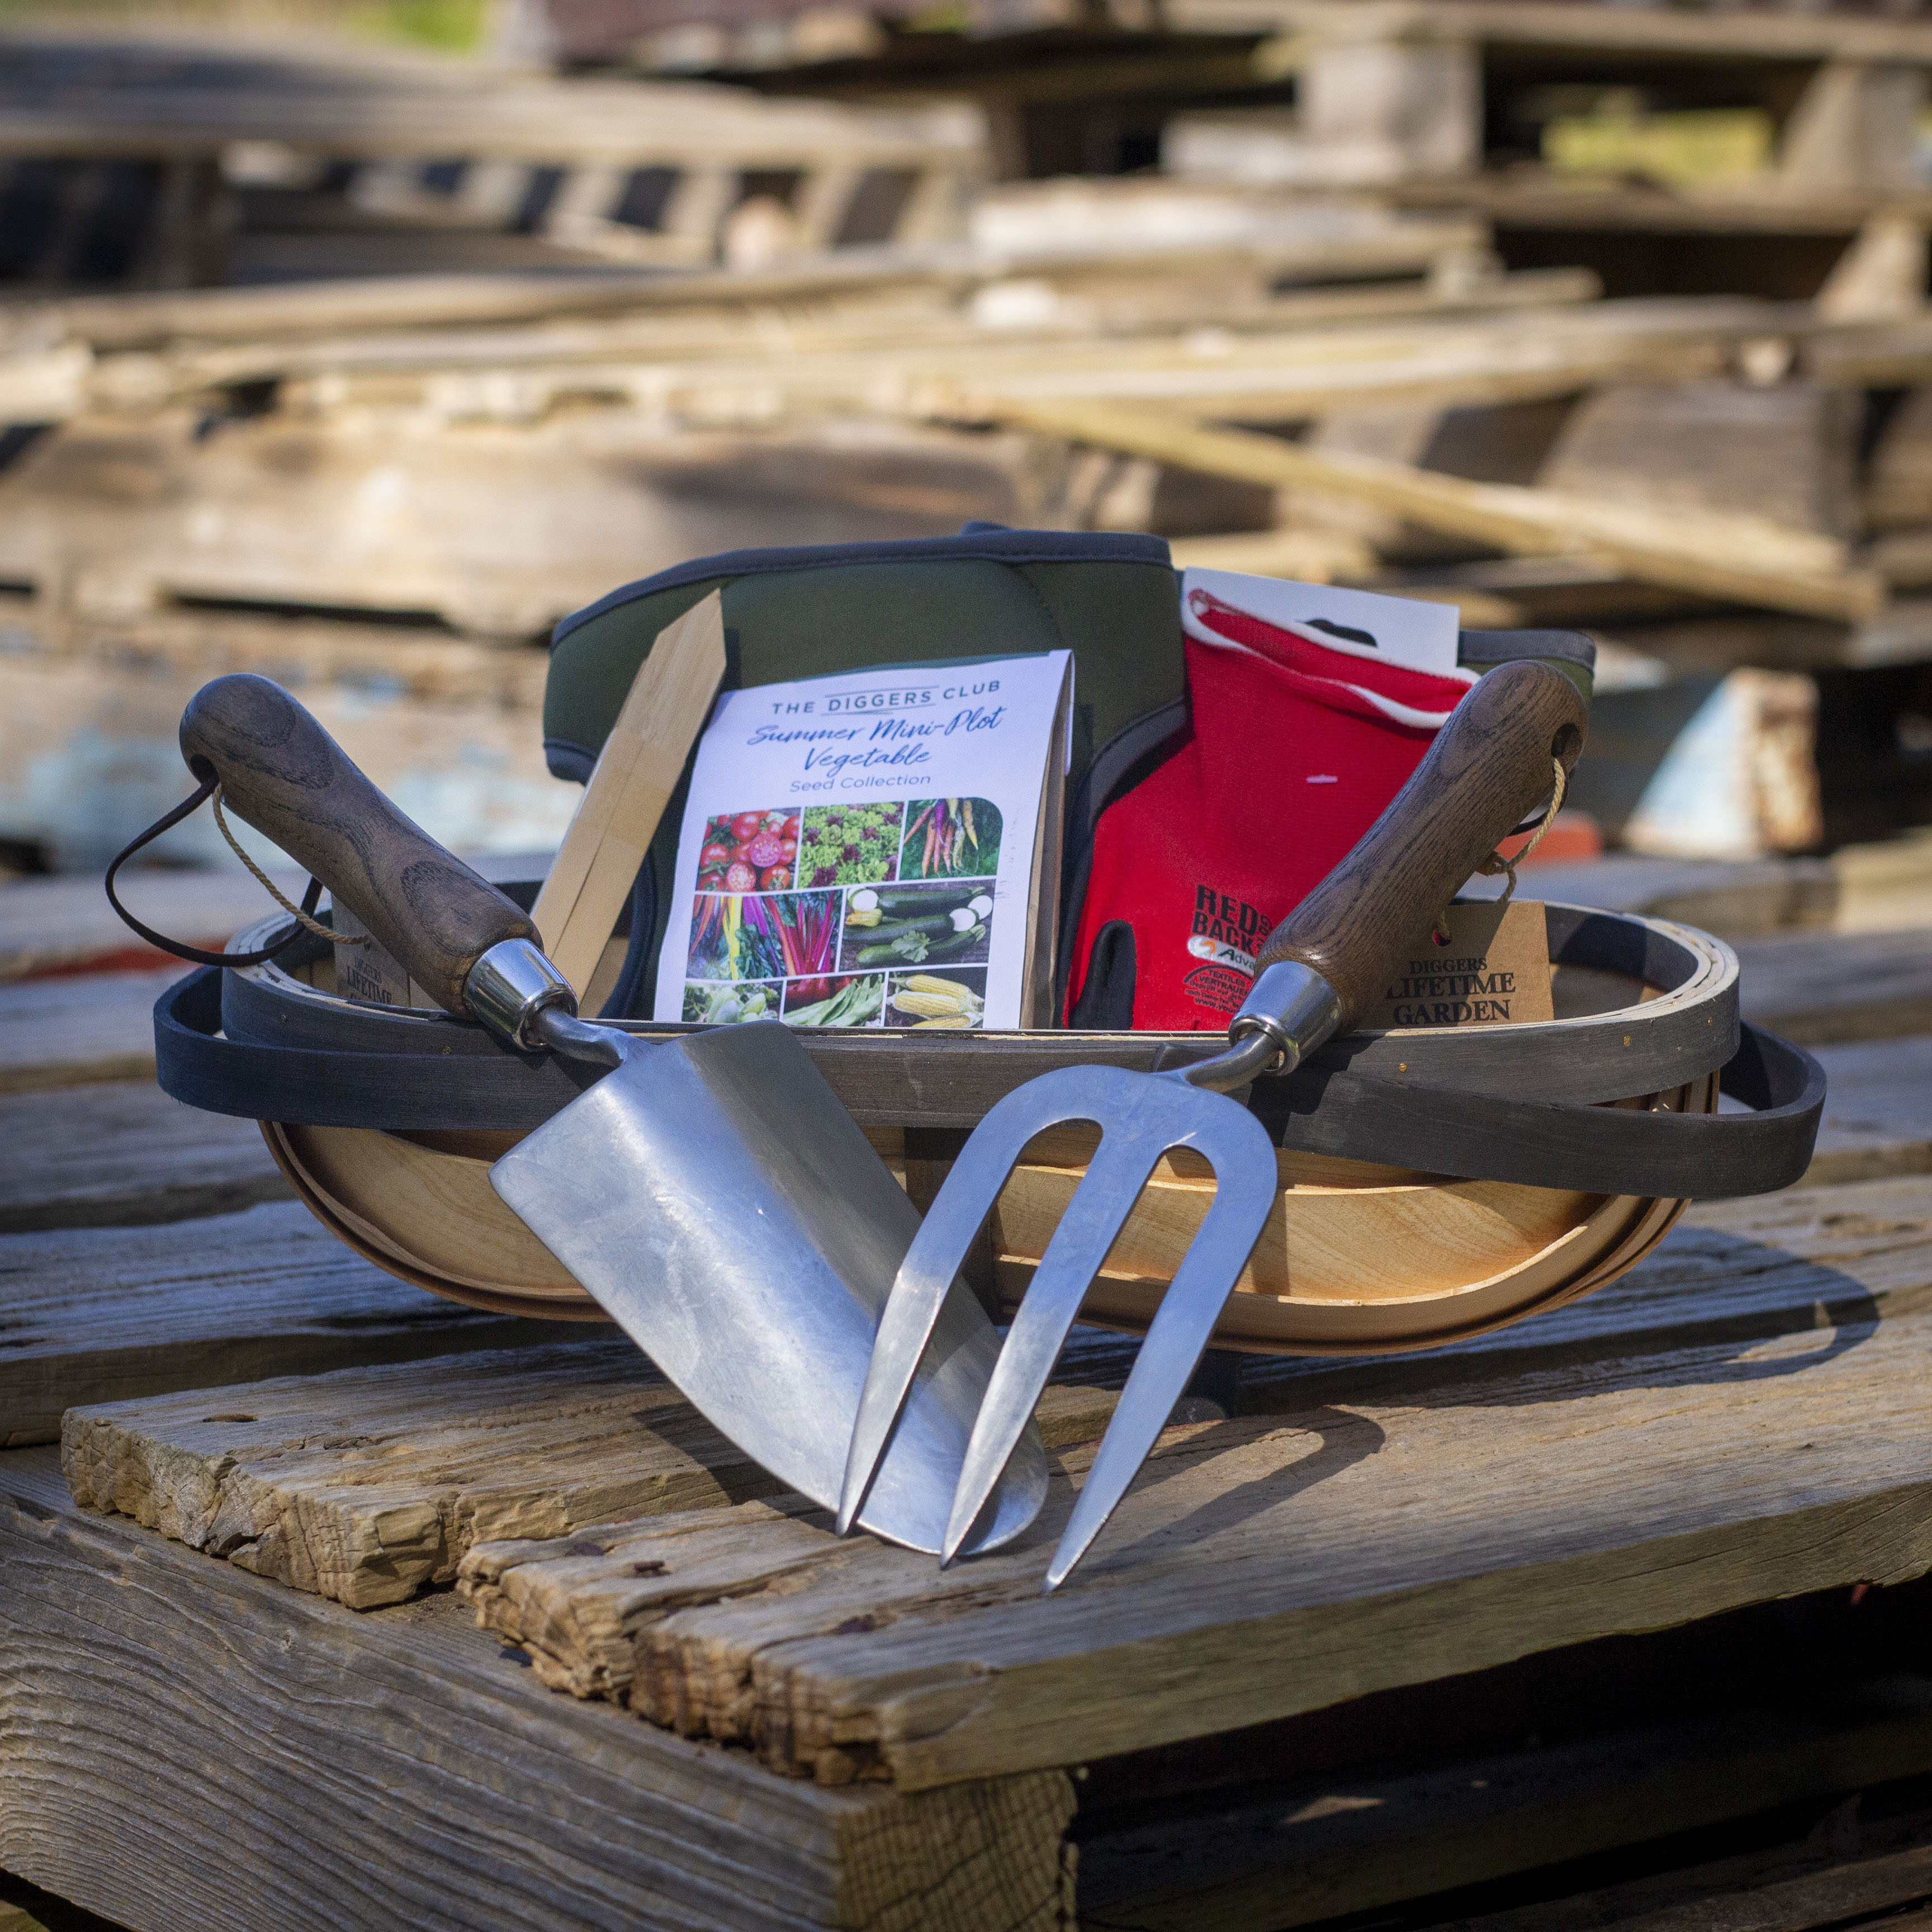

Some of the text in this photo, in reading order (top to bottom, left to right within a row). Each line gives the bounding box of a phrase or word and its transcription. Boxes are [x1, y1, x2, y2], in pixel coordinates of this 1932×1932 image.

[773, 680, 1000, 714] THE DIGGERS CLUB
[747, 706, 1007, 745] Summer Mini-Plot
[804, 742, 932, 778] Vegetable
[790, 775, 931, 792] Seed Collection
[1196, 884, 1258, 936] RED
[1192, 911, 1254, 957] BACK
[1209, 969, 1246, 987] TEXTILES
[1409, 957, 1487, 974] DIGGERS
[1393, 1000, 1511, 1026] GARDEN
